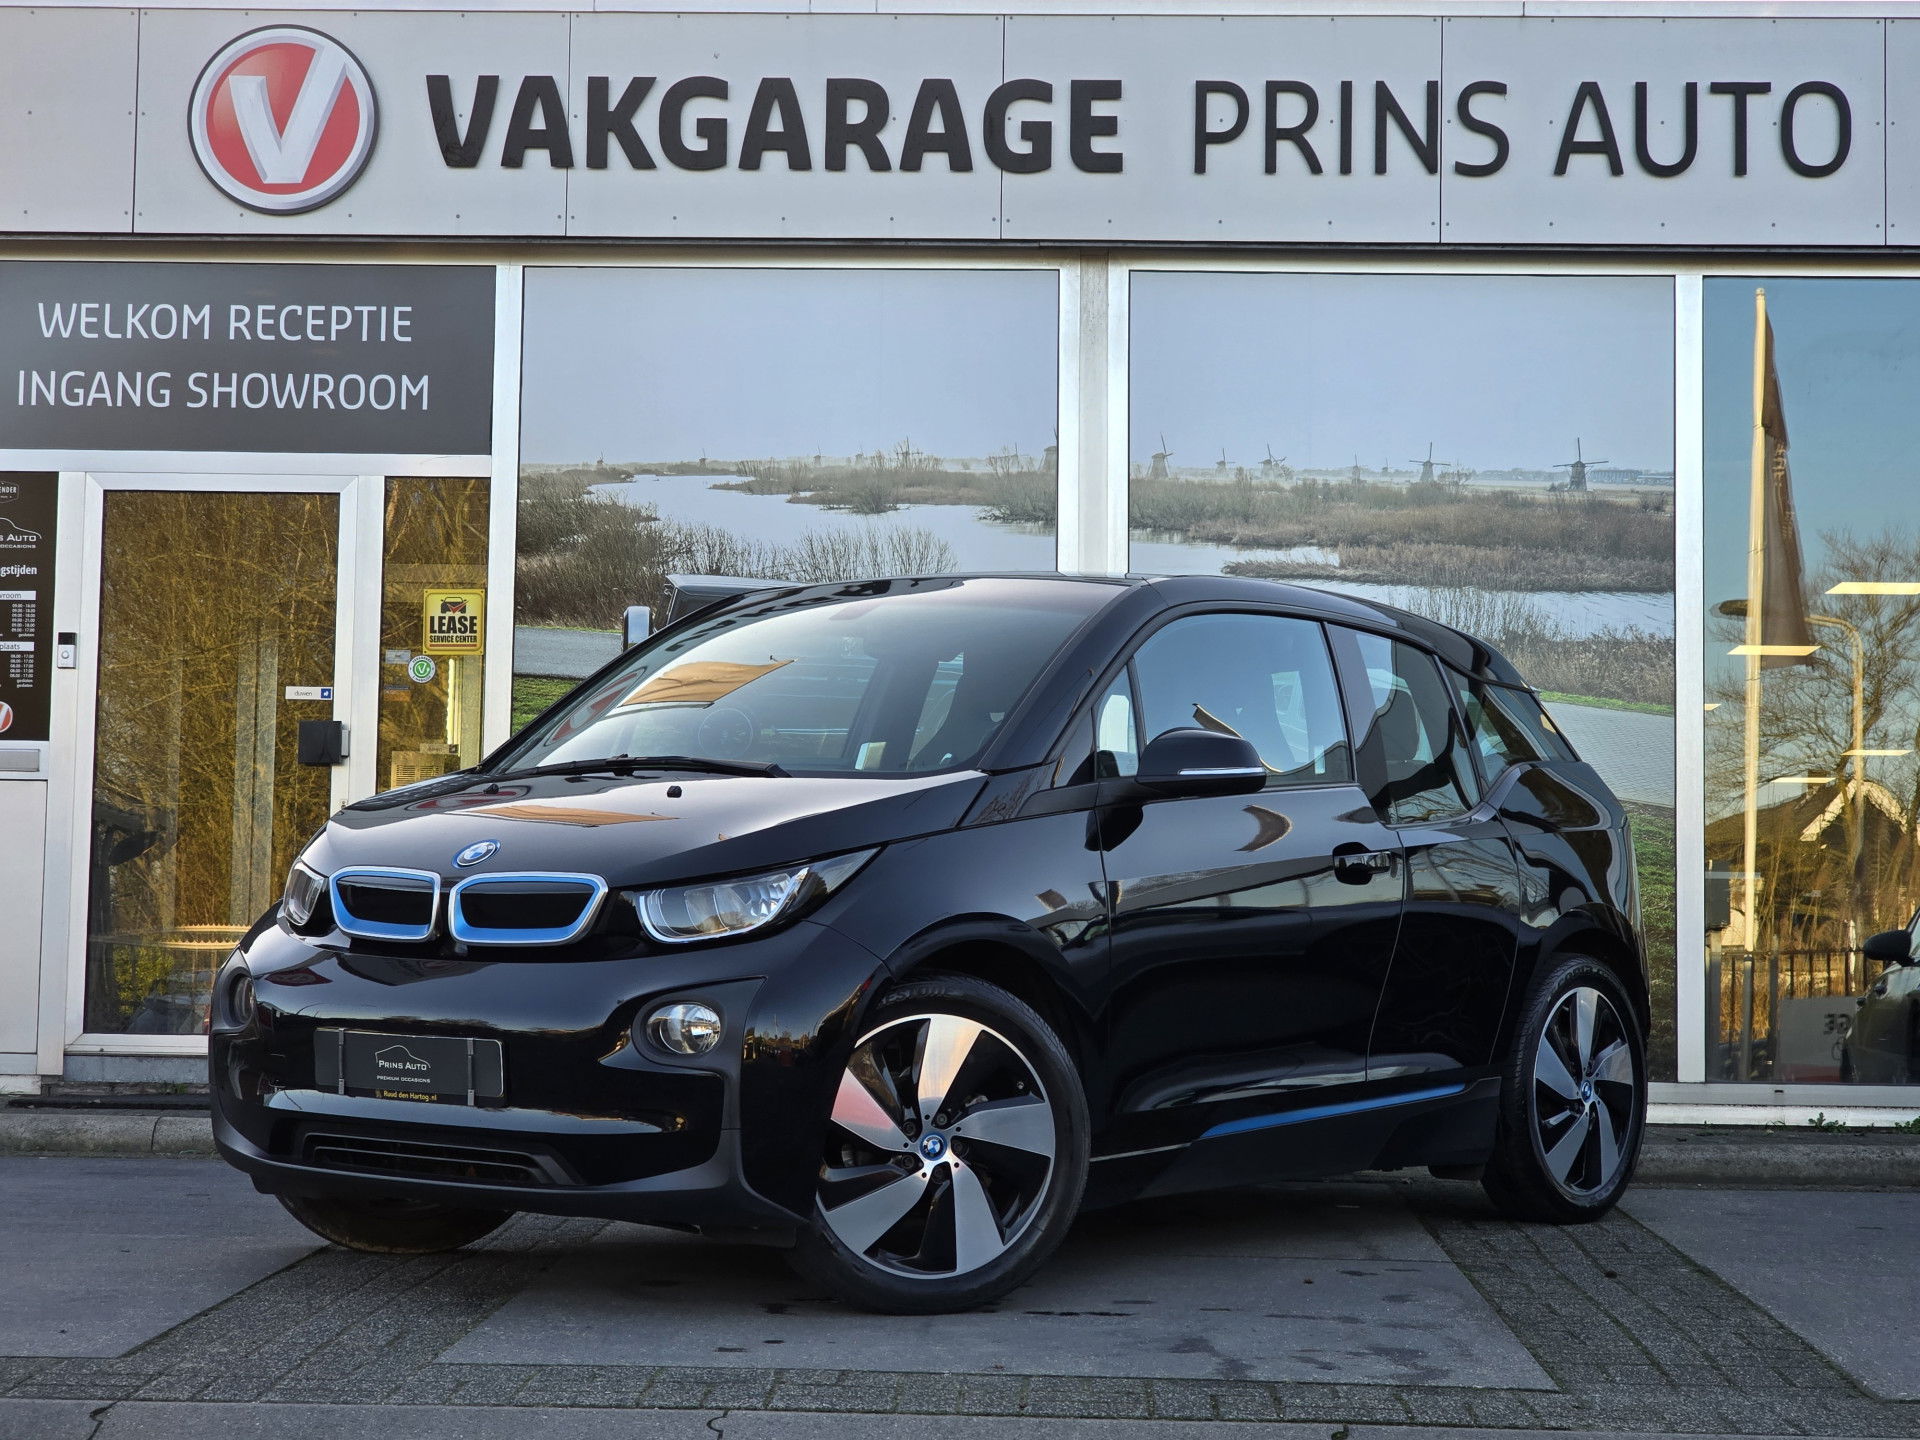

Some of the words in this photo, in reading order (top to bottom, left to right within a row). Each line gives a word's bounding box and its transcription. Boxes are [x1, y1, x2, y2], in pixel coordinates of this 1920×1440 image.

[425, 73, 1123, 175] VAKGARAGE
[1193, 78, 1509, 178] PRINS
[1553, 80, 1853, 179] AUTO
[37, 302, 211, 340] WELKOM
[229, 304, 413, 342] RECEPTIE
[17, 370, 173, 408] INGANG
[186, 372, 430, 411] SHOWROOM
[6, 533, 37, 542] AUTO
[0, 565, 38, 577] gstijden
[429, 615, 478, 634] LEASE
[429, 635, 454, 643] SERVICE
[455, 635, 478, 643] CENTER
[378, 1060, 403, 1069] PRINS
[405, 1062, 427, 1070] AUTO
